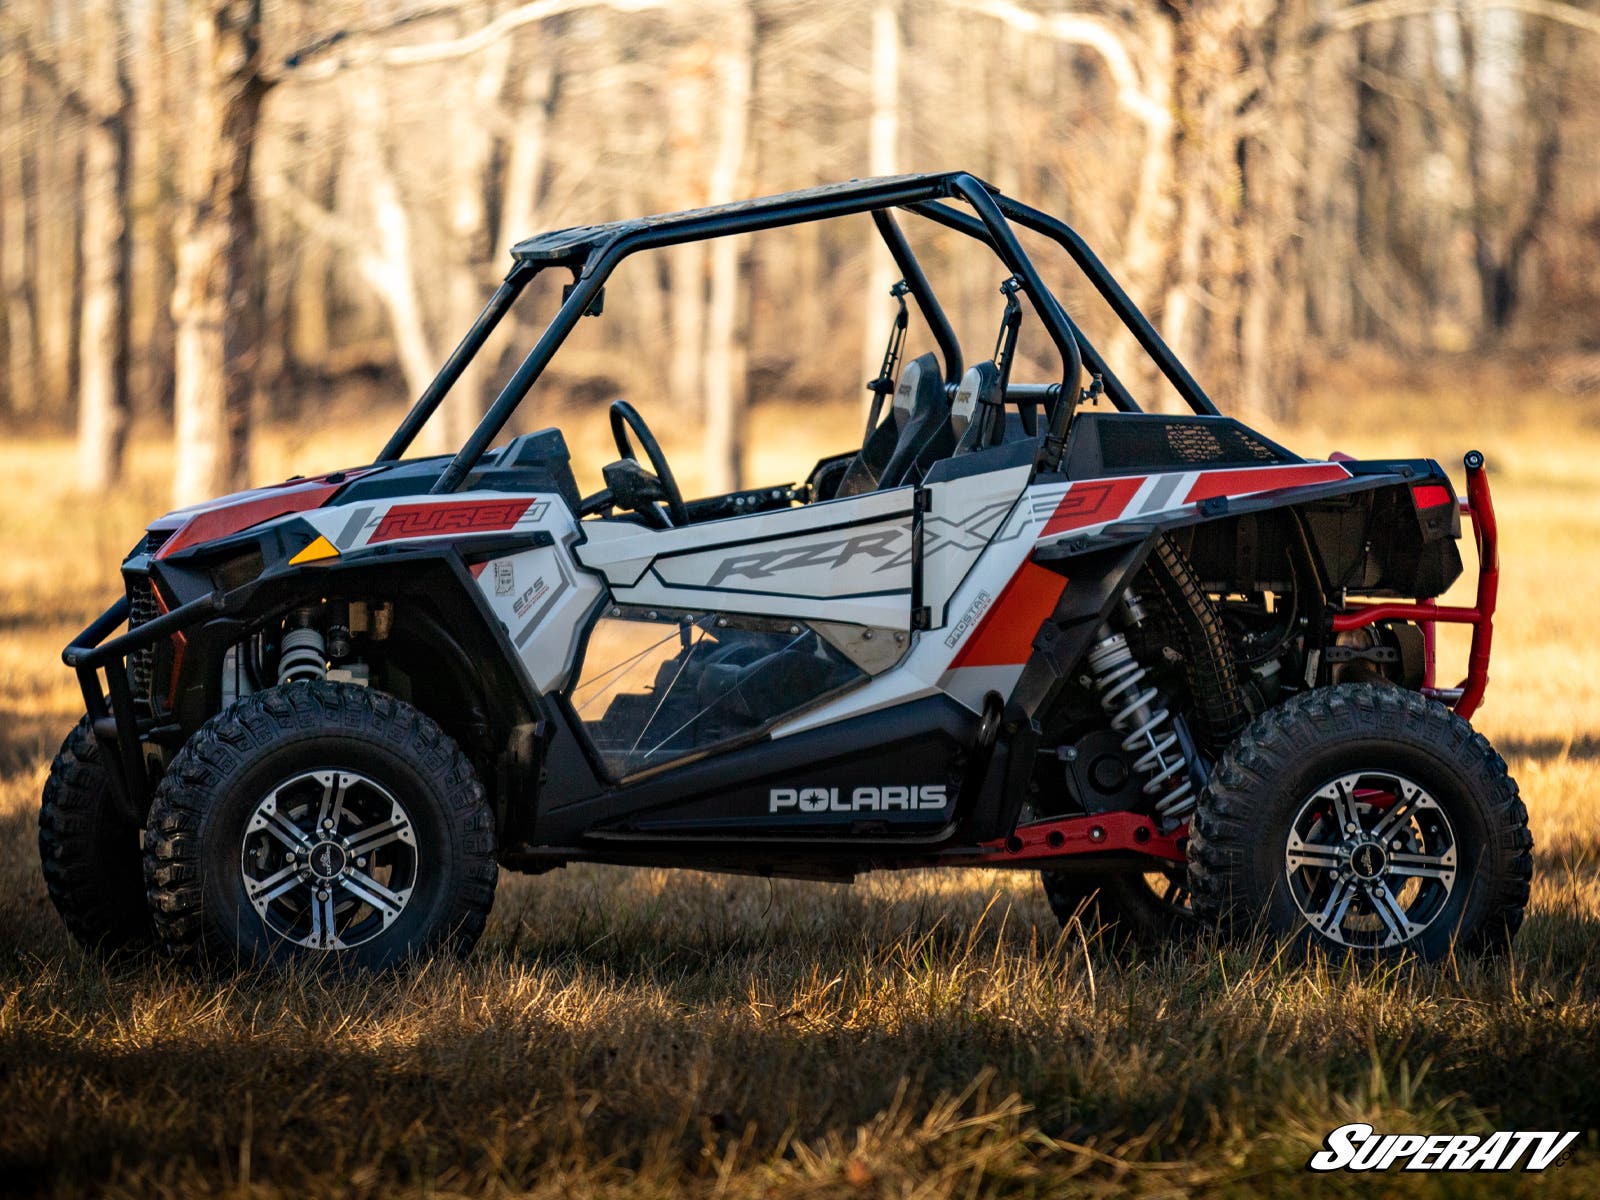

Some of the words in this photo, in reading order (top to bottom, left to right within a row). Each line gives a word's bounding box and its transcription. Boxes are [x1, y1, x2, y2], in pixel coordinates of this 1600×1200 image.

[364, 501, 551, 537] TURBO
[705, 529, 902, 586] RZR
[513, 576, 544, 613] EPS
[944, 590, 990, 648] PROSTAR
[769, 785, 947, 812] POLARIS
